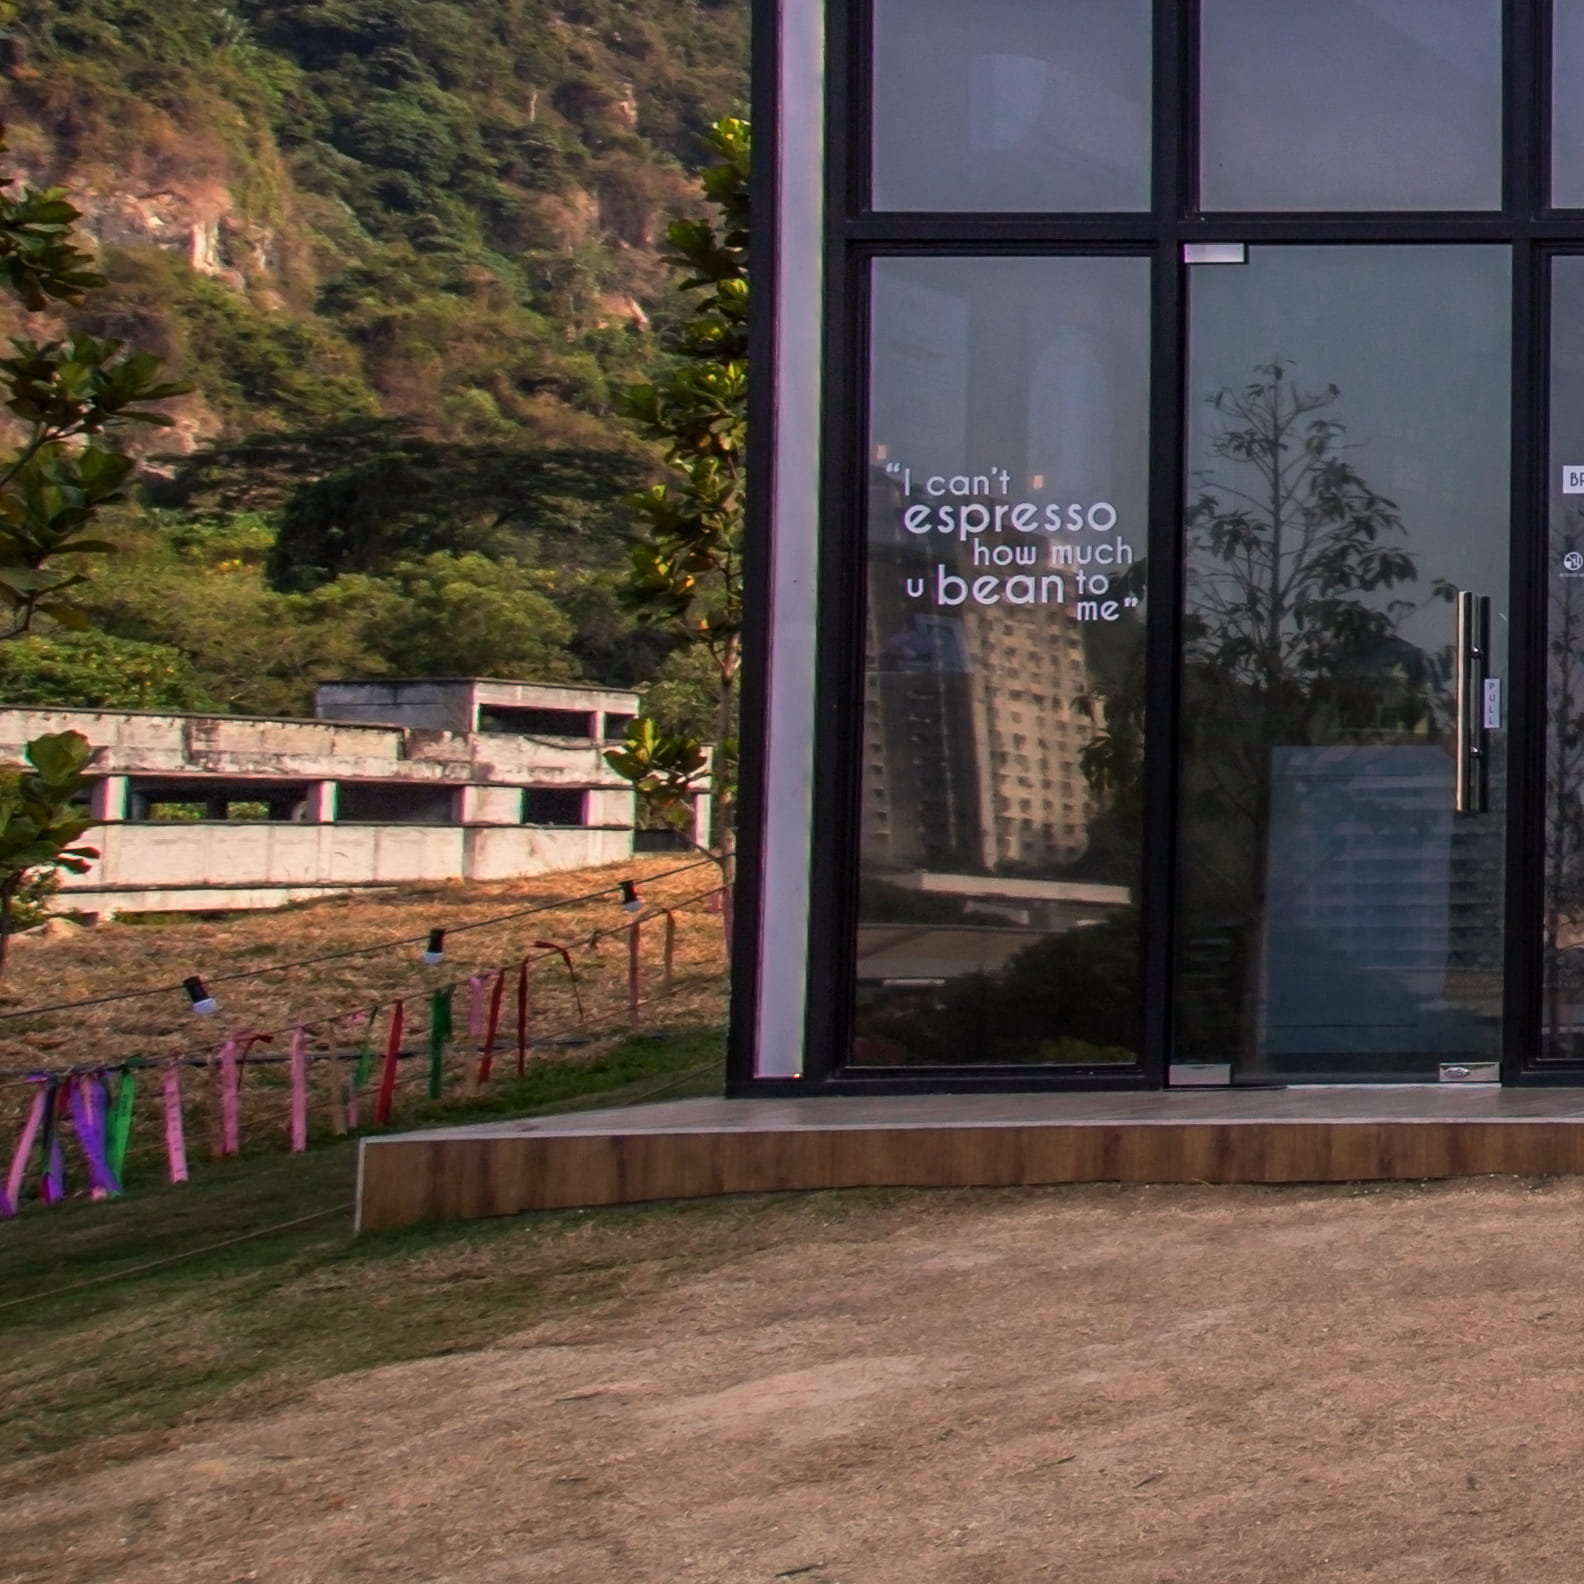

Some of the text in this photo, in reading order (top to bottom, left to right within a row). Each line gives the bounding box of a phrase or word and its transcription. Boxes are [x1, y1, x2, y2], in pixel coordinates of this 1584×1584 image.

[926, 466, 1011, 497] can't
[903, 501, 1118, 542] espresso
[973, 535, 1133, 566] how much
[907, 563, 1110, 606] u bean to
[1488, 682, 1497, 726] PULL
